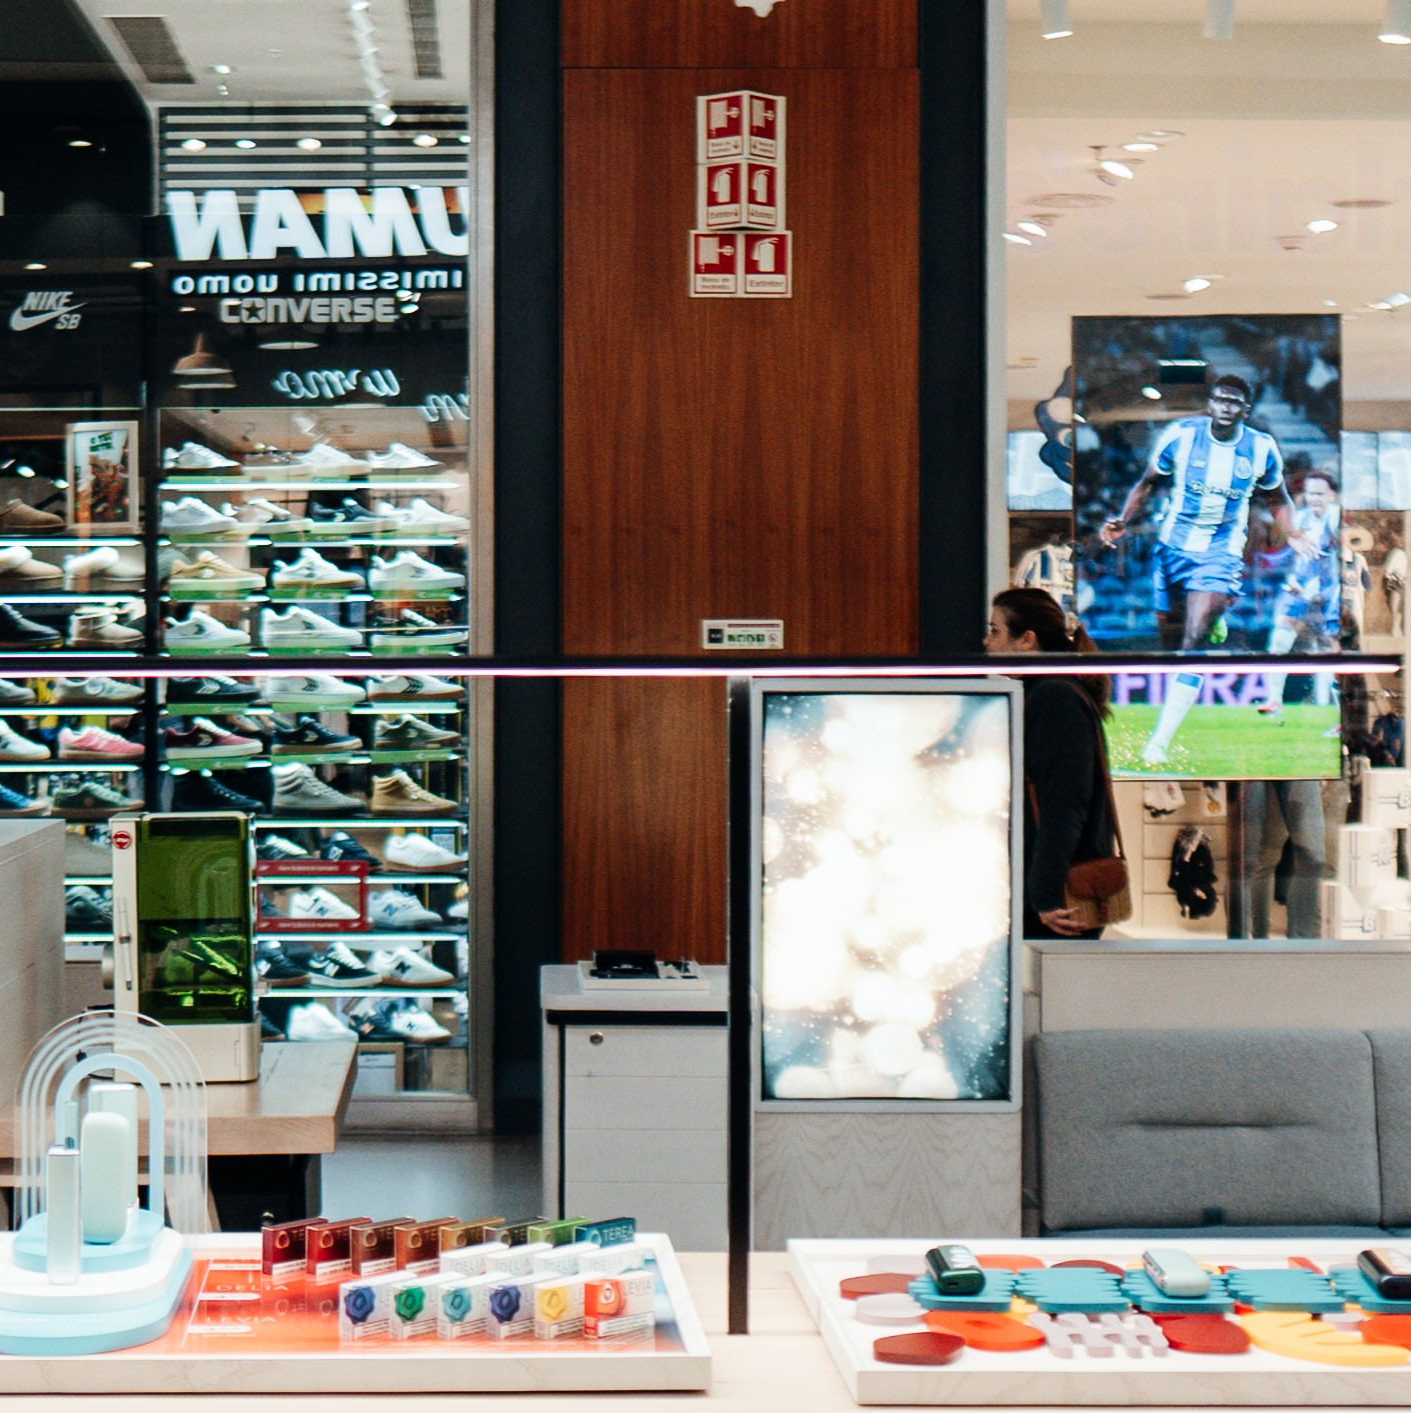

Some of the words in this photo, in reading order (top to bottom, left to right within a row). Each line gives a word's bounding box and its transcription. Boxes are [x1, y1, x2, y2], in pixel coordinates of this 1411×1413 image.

[22, 291, 74, 311] NIKE
[220, 297, 400, 324] CONVERSE
[55, 314, 82, 330] SB
[602, 1225, 635, 1242] TEREA
[623, 1278, 652, 1297] LEVIA
